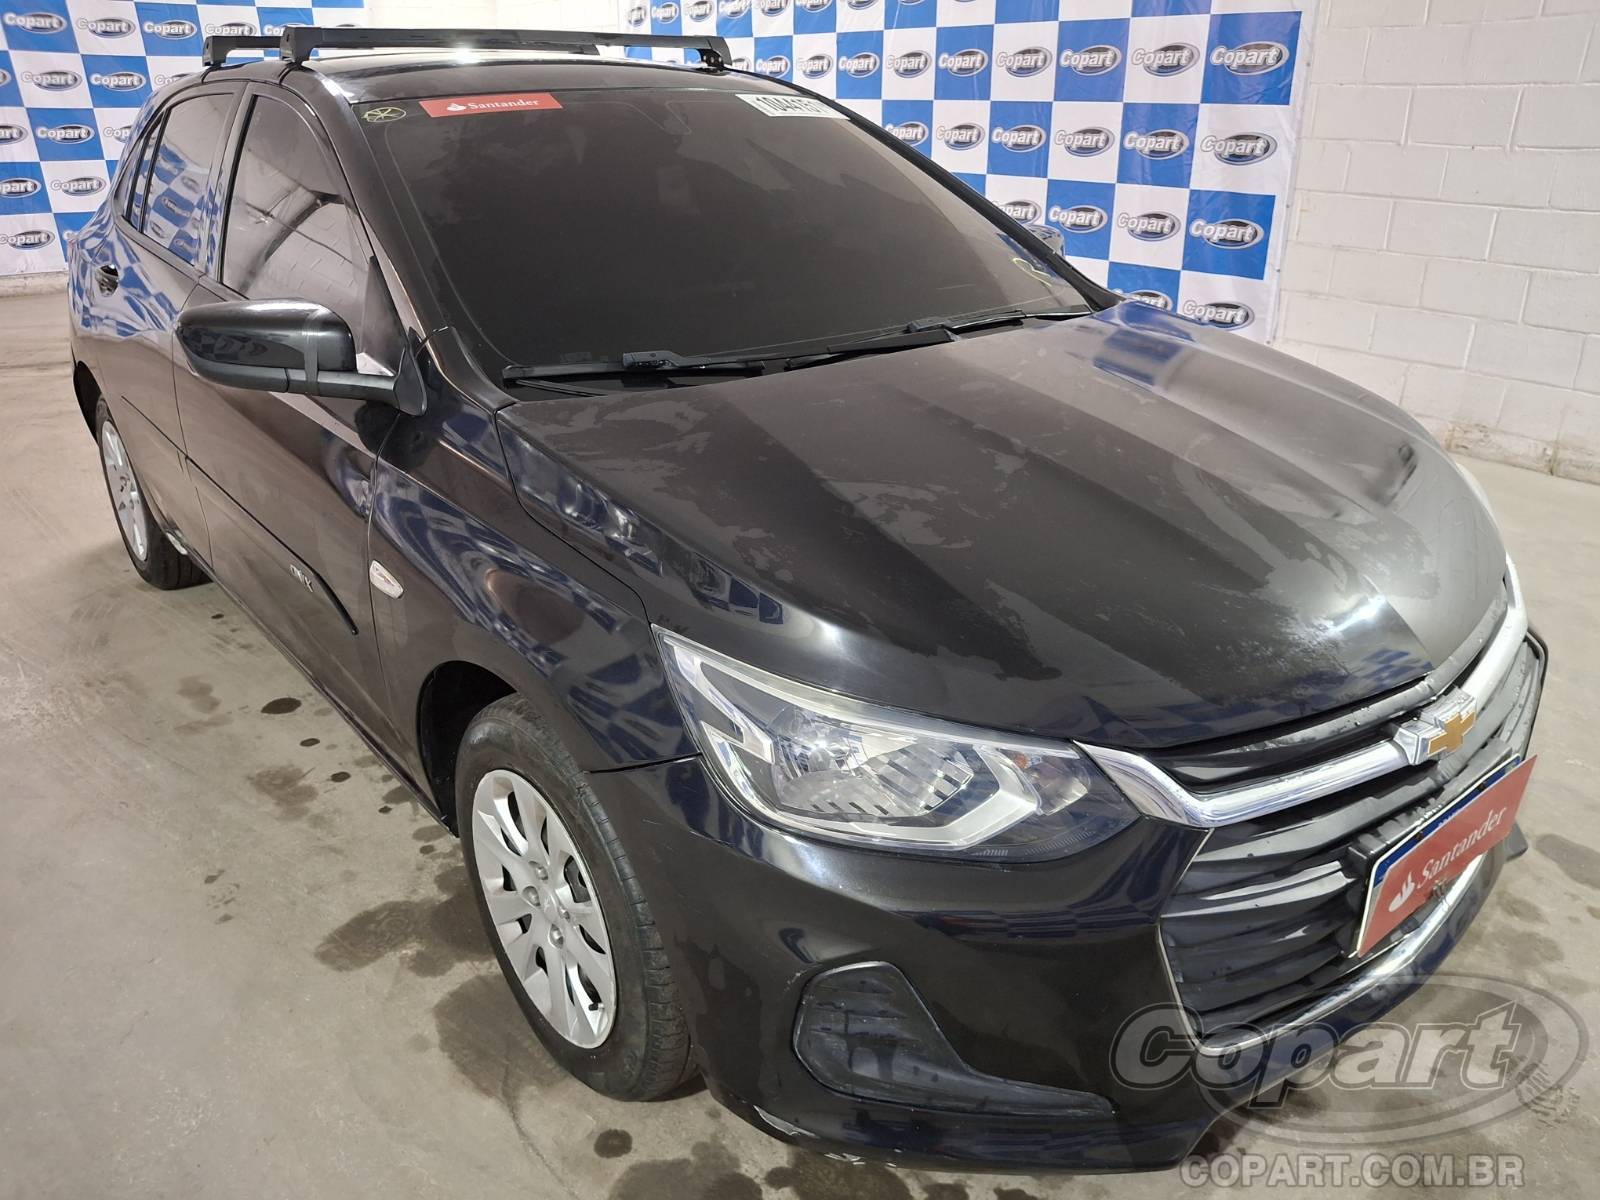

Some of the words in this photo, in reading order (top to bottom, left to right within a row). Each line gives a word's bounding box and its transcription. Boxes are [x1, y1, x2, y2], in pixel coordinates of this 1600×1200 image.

[4, 12, 61, 29] Copart
[76, 17, 129, 34] Copart
[143, 22, 193, 37] Copart
[205, 22, 251, 37] Copart
[839, 55, 874, 71] Copart
[886, 54, 926, 71] Copart
[939, 52, 982, 71] Copart
[997, 50, 1045, 69] Copart
[1060, 48, 1114, 68] Copart
[1132, 48, 1190, 69] Copart
[1211, 45, 1281, 69] Copart
[756, 58, 787, 75] Copart
[21, 70, 75, 87] Copart
[90, 73, 140, 88] Copart
[468, 99, 540, 111] Santander
[0, 126, 18, 141] art
[37, 125, 88, 142] Copart
[104, 127, 132, 141] Cop
[936, 125, 979, 145] Copart
[992, 127, 1041, 147] Copart
[1055, 130, 1107, 151] Copart
[1124, 131, 1182, 154] Copart
[1202, 136, 1268, 158] Copart
[0, 180, 34, 198] part
[51, 177, 101, 193] Copart
[1049, 205, 1101, 227] Copart
[1118, 212, 1173, 234] Copart
[1191, 219, 1254, 243] Copart
[1184, 300, 1247, 324] Copart
[1417, 806, 1507, 889] Santander
